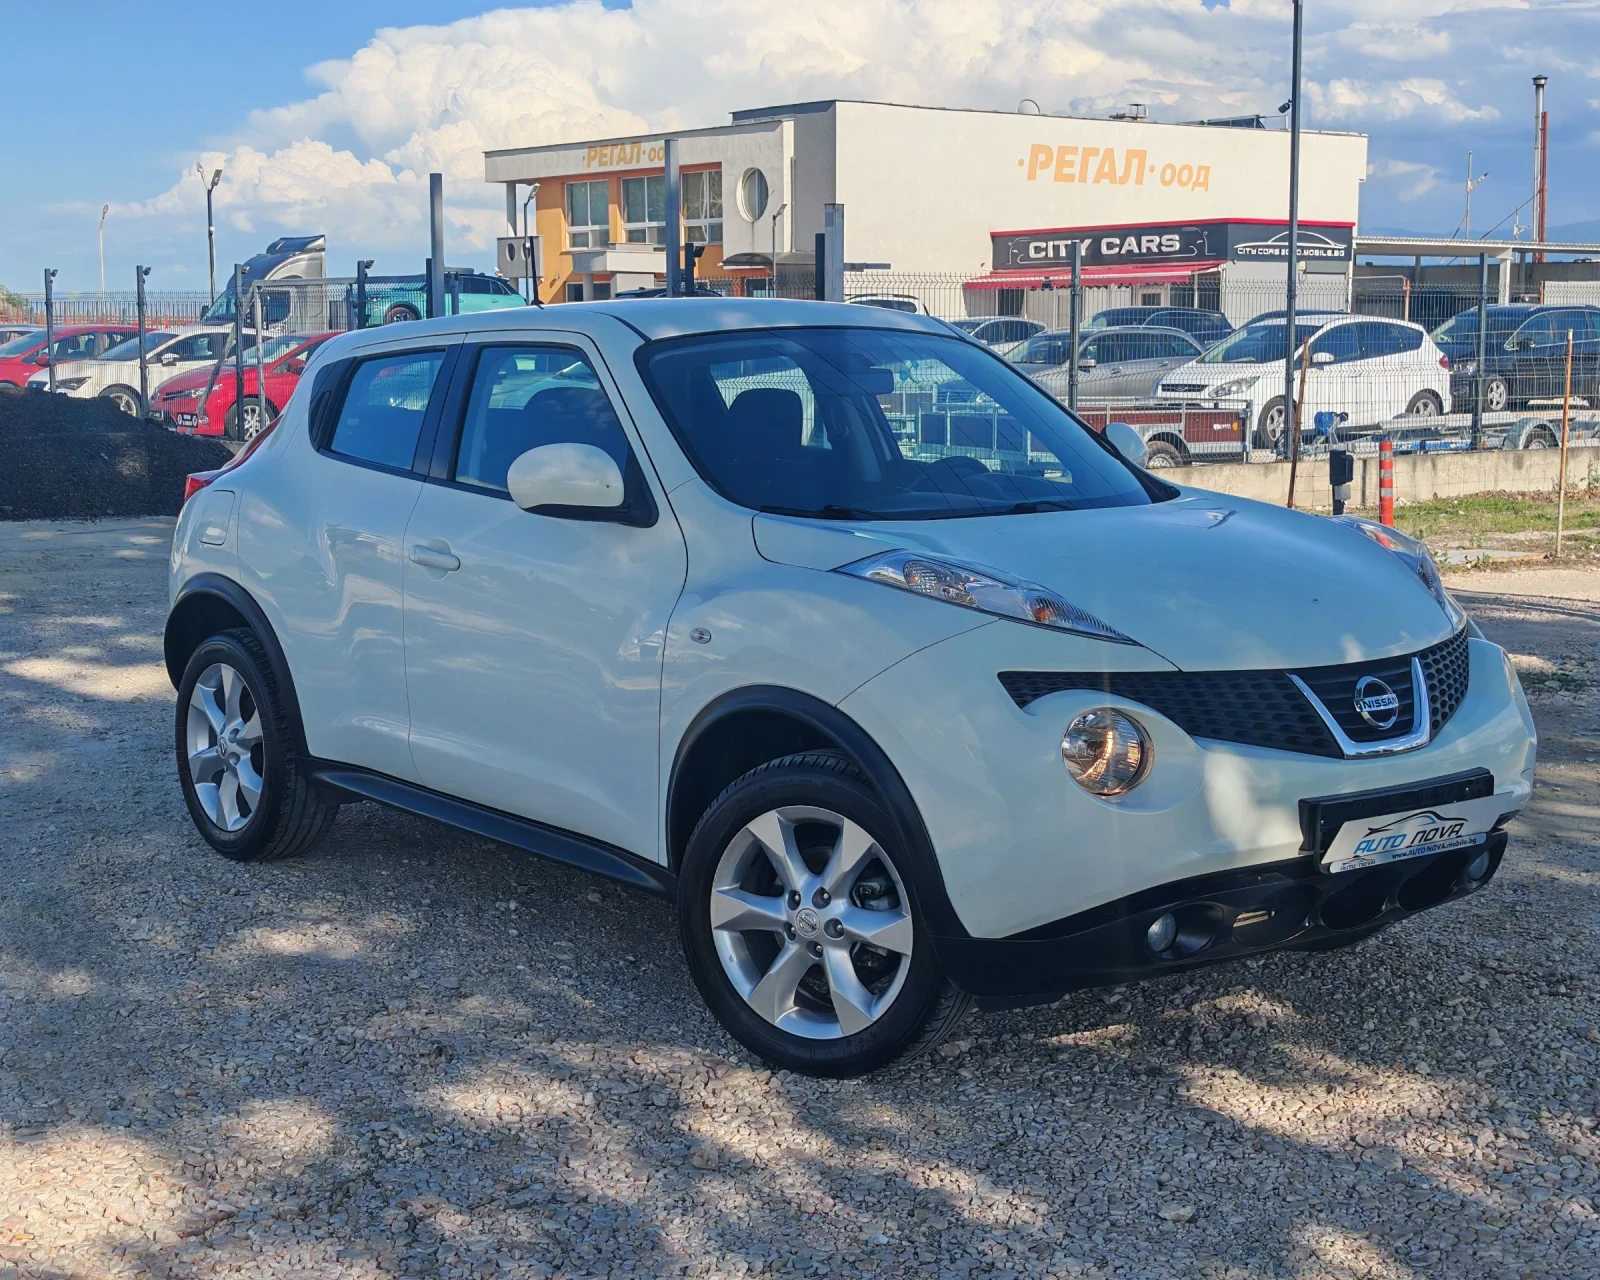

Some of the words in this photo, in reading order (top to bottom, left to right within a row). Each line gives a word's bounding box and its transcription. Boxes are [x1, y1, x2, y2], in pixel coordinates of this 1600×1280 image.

[1027, 143, 1147, 186] РЕГАЛ
[1028, 238, 1092, 258] CITY
[1101, 234, 1180, 255] CARS
[1362, 696, 1398, 709] NISSAN
[1353, 834, 1407, 854] AUTO
